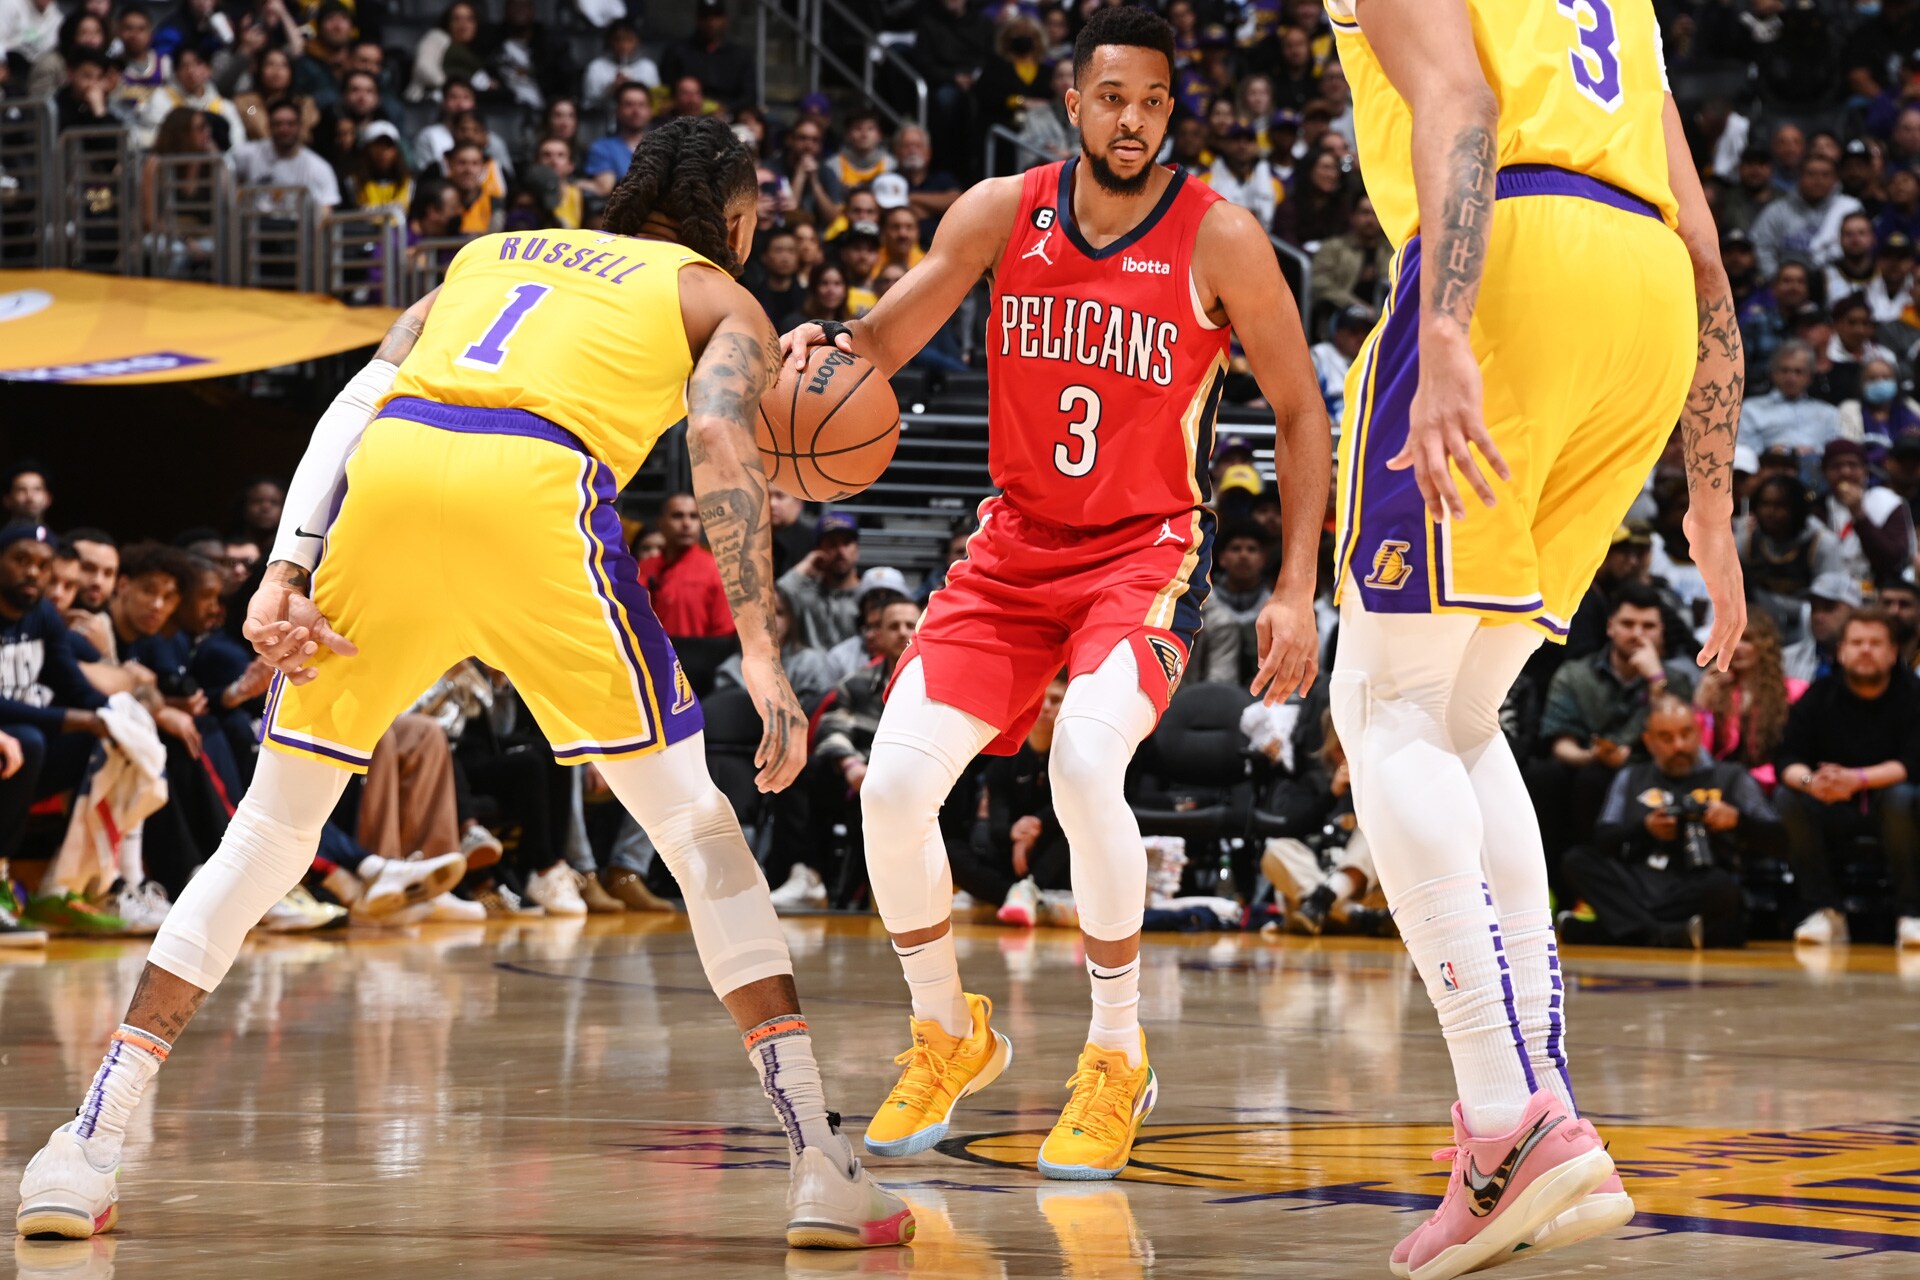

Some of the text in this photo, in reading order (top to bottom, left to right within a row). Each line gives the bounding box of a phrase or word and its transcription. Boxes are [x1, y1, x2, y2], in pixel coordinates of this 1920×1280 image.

[1555, 0, 1624, 115] 3
[498, 236, 647, 285] RUSSELL
[1035, 208, 1055, 230] 6
[1121, 256, 1171, 275] ibotta
[454, 281, 556, 373] 1
[1000, 294, 1179, 387] PELICANS
[1053, 383, 1102, 478] 3
